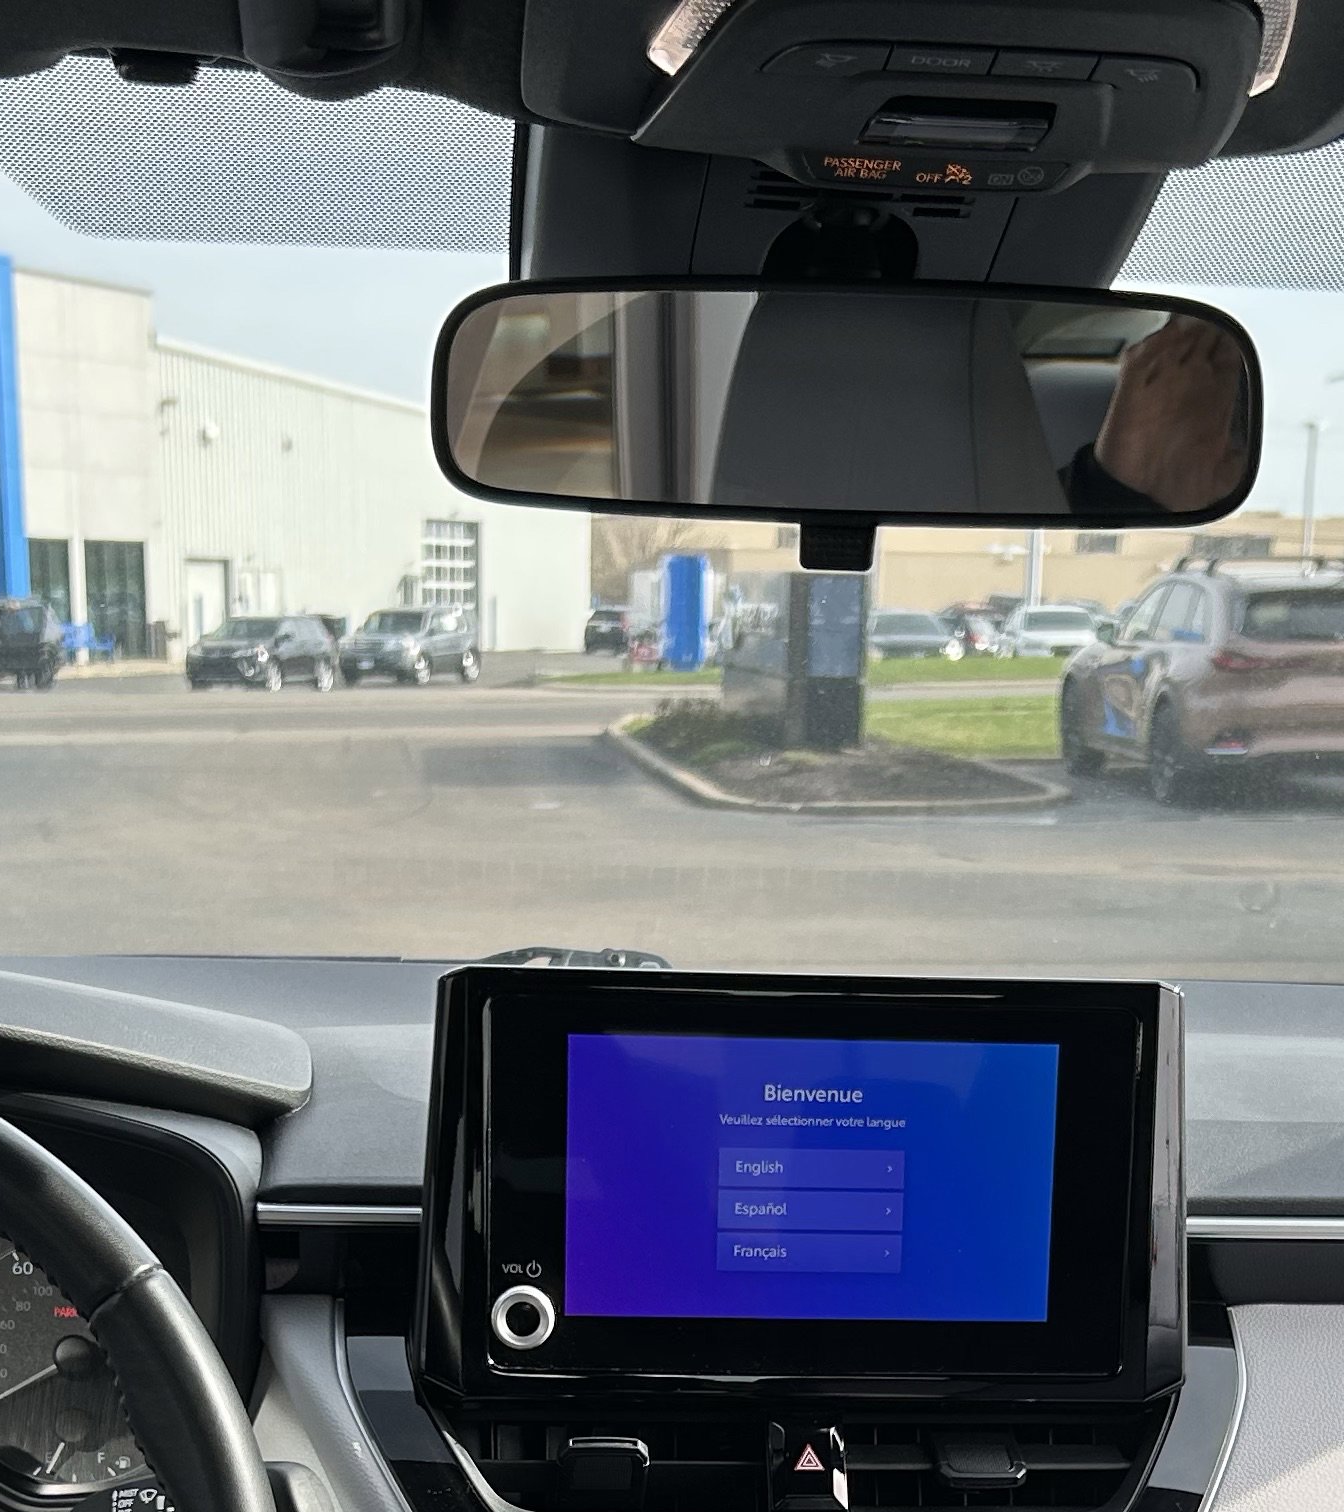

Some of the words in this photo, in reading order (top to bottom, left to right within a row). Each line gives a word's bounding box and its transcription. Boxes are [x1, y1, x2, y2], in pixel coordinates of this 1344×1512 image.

[911, 55, 972, 68] DOOR
[824, 156, 902, 171] PASSENGER
[834, 168, 857, 177] AIR
[859, 169, 888, 180] BAG
[915, 172, 944, 184] OFF
[764, 1084, 864, 1103] Bienvenue
[719, 1113, 763, 1126] Veuillez
[765, 1114, 833, 1127] sélectionner
[836, 1117, 864, 1127] votre
[866, 1116, 906, 1130] langue
[735, 1160, 784, 1176] English
[734, 1202, 788, 1217] Español
[733, 1244, 788, 1260] Français
[12, 1261, 33, 1275] 60
[501, 1263, 524, 1274] VOL
[32, 1285, 53, 1297] 100
[15, 1301, 31, 1312] 80
[0, 1319, 16, 1330] 60
[97, 1452, 106, 1464] F
[118, 1488, 139, 1498] MIST
[118, 1499, 134, 1509] OFF
